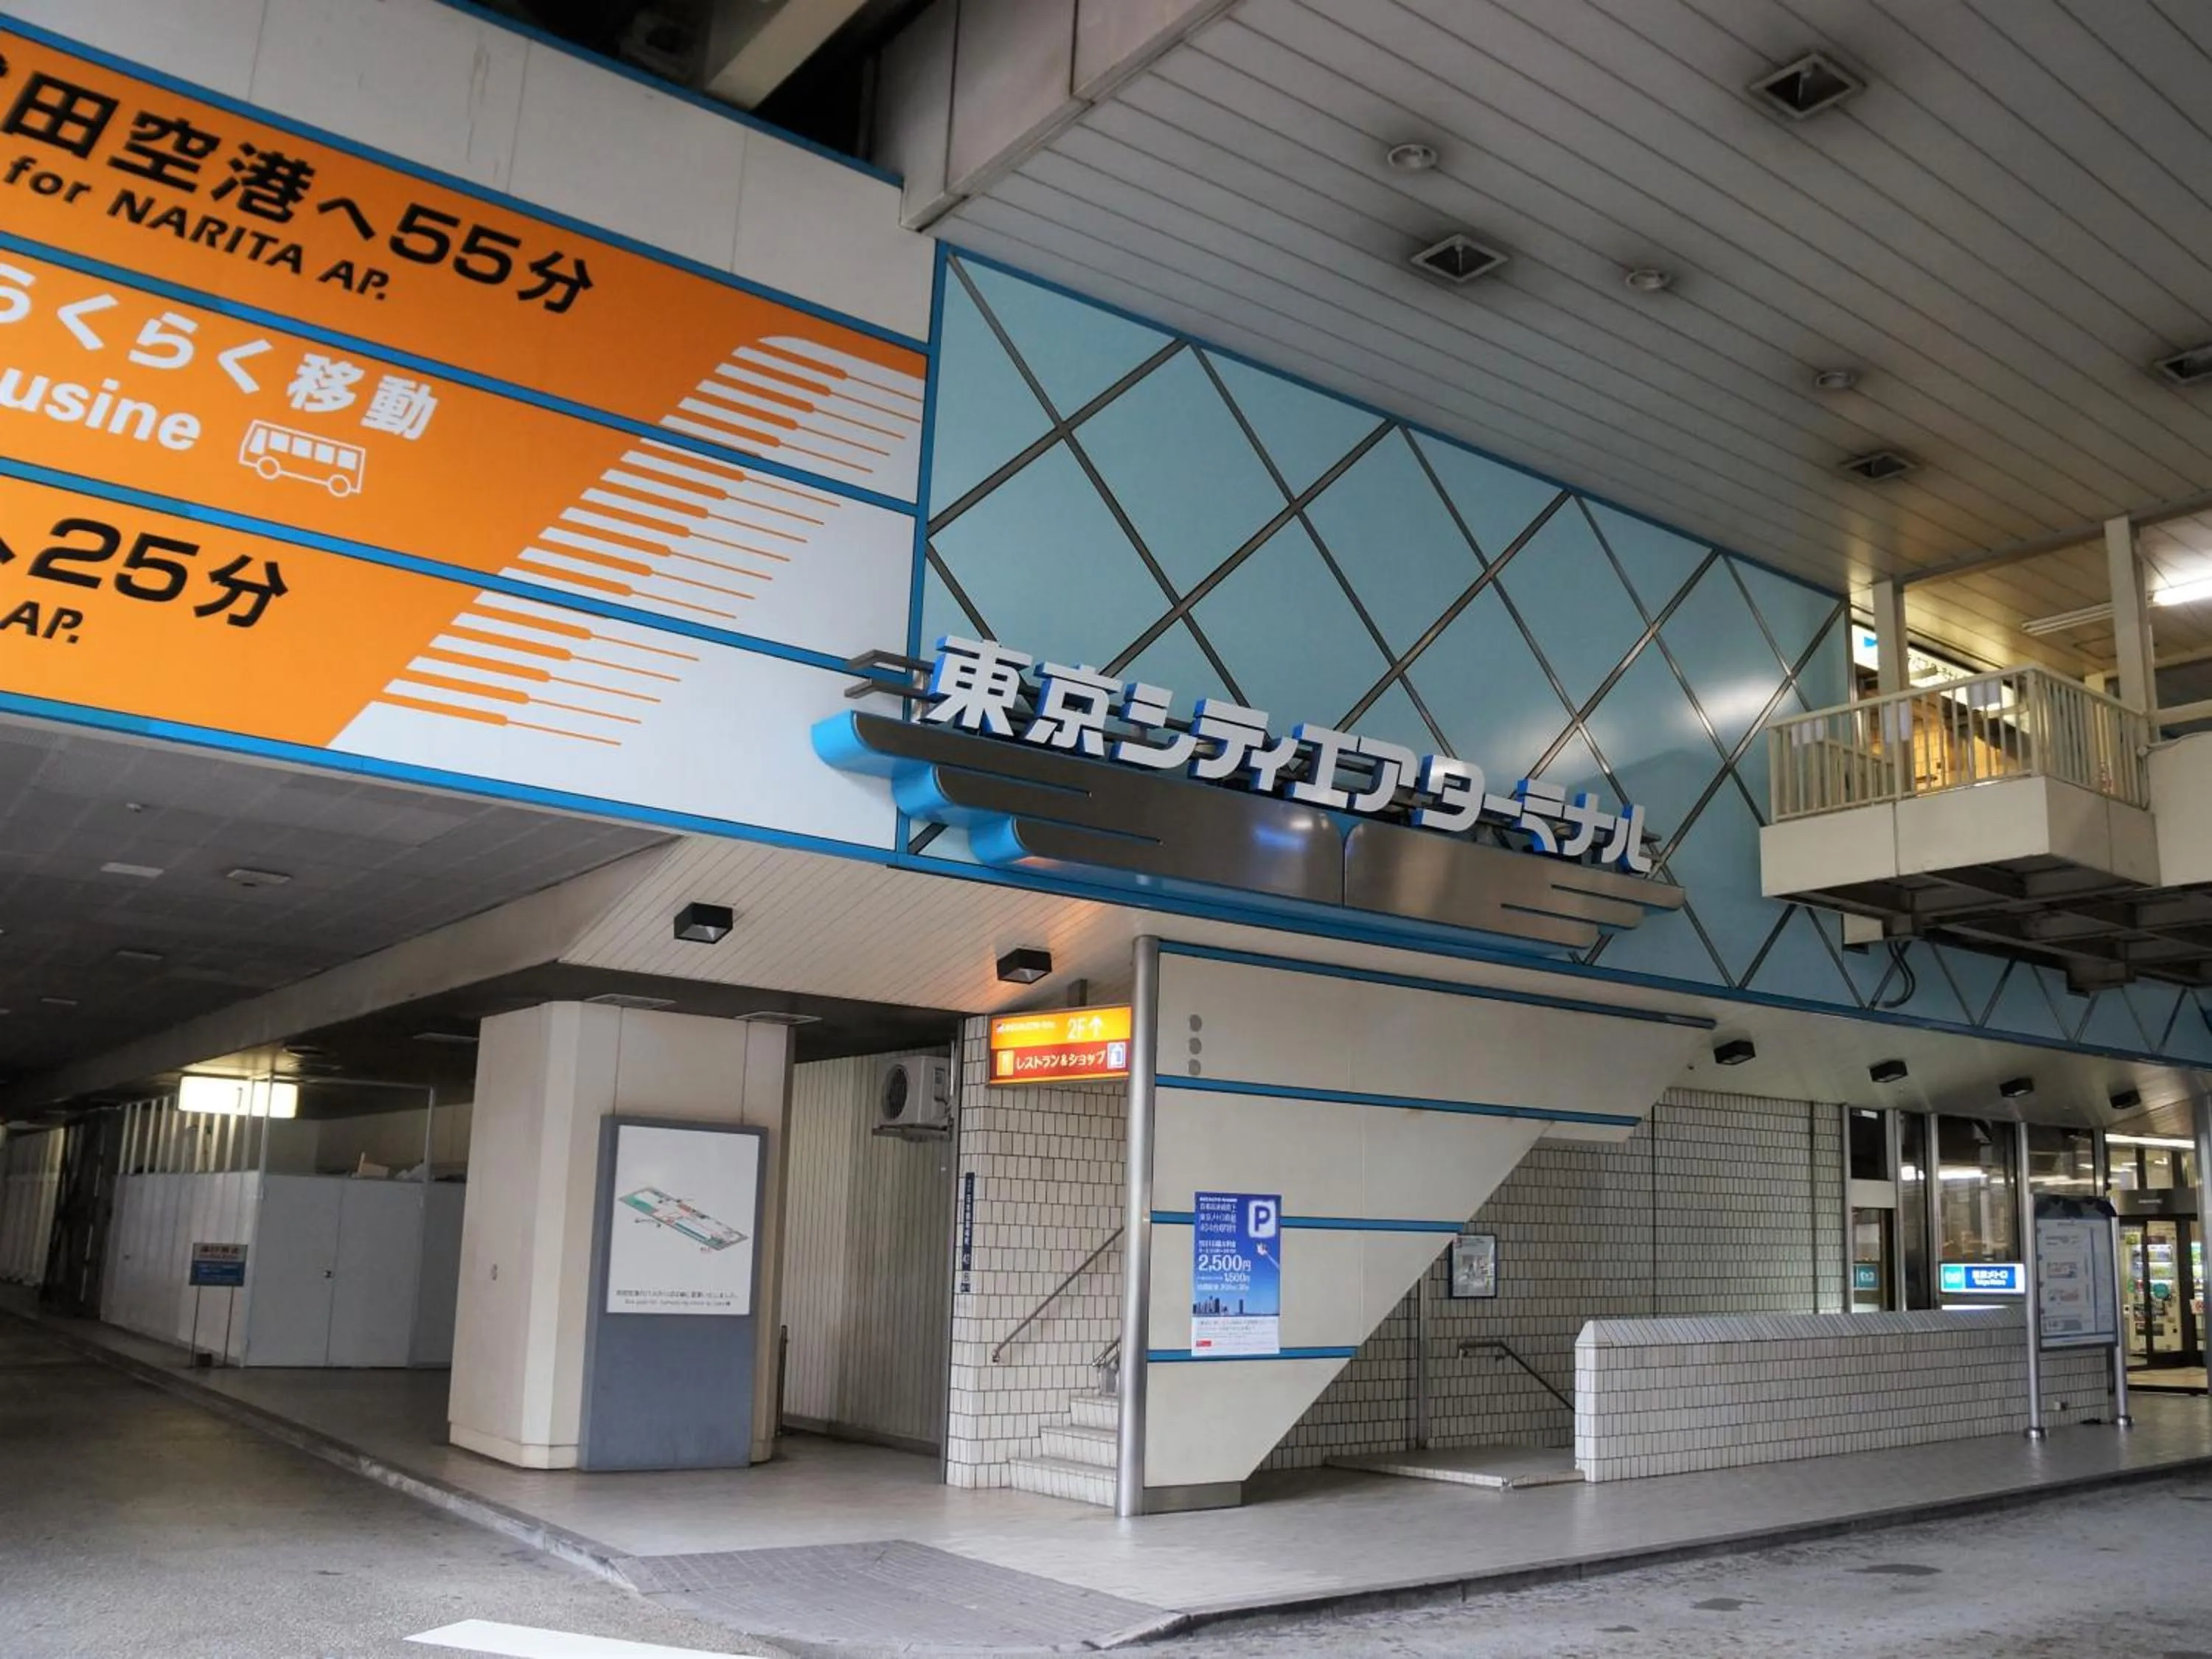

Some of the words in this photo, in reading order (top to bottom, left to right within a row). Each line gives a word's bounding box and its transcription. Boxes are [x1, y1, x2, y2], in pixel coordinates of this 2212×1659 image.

[0, 53, 594, 313] 田空港へ55分
[4, 156, 91, 204] for
[106, 189, 302, 275] NARITA
[317, 259, 390, 301] AP.
[0, 518, 288, 627] 25分
[0, 600, 84, 644] AP.
[918, 636, 1652, 873] 東京シティエアターミナル
[1067, 1018, 1086, 1040] 2F
[1254, 1205, 1271, 1232] P
[1198, 1255, 1251, 1272] 2,500円
